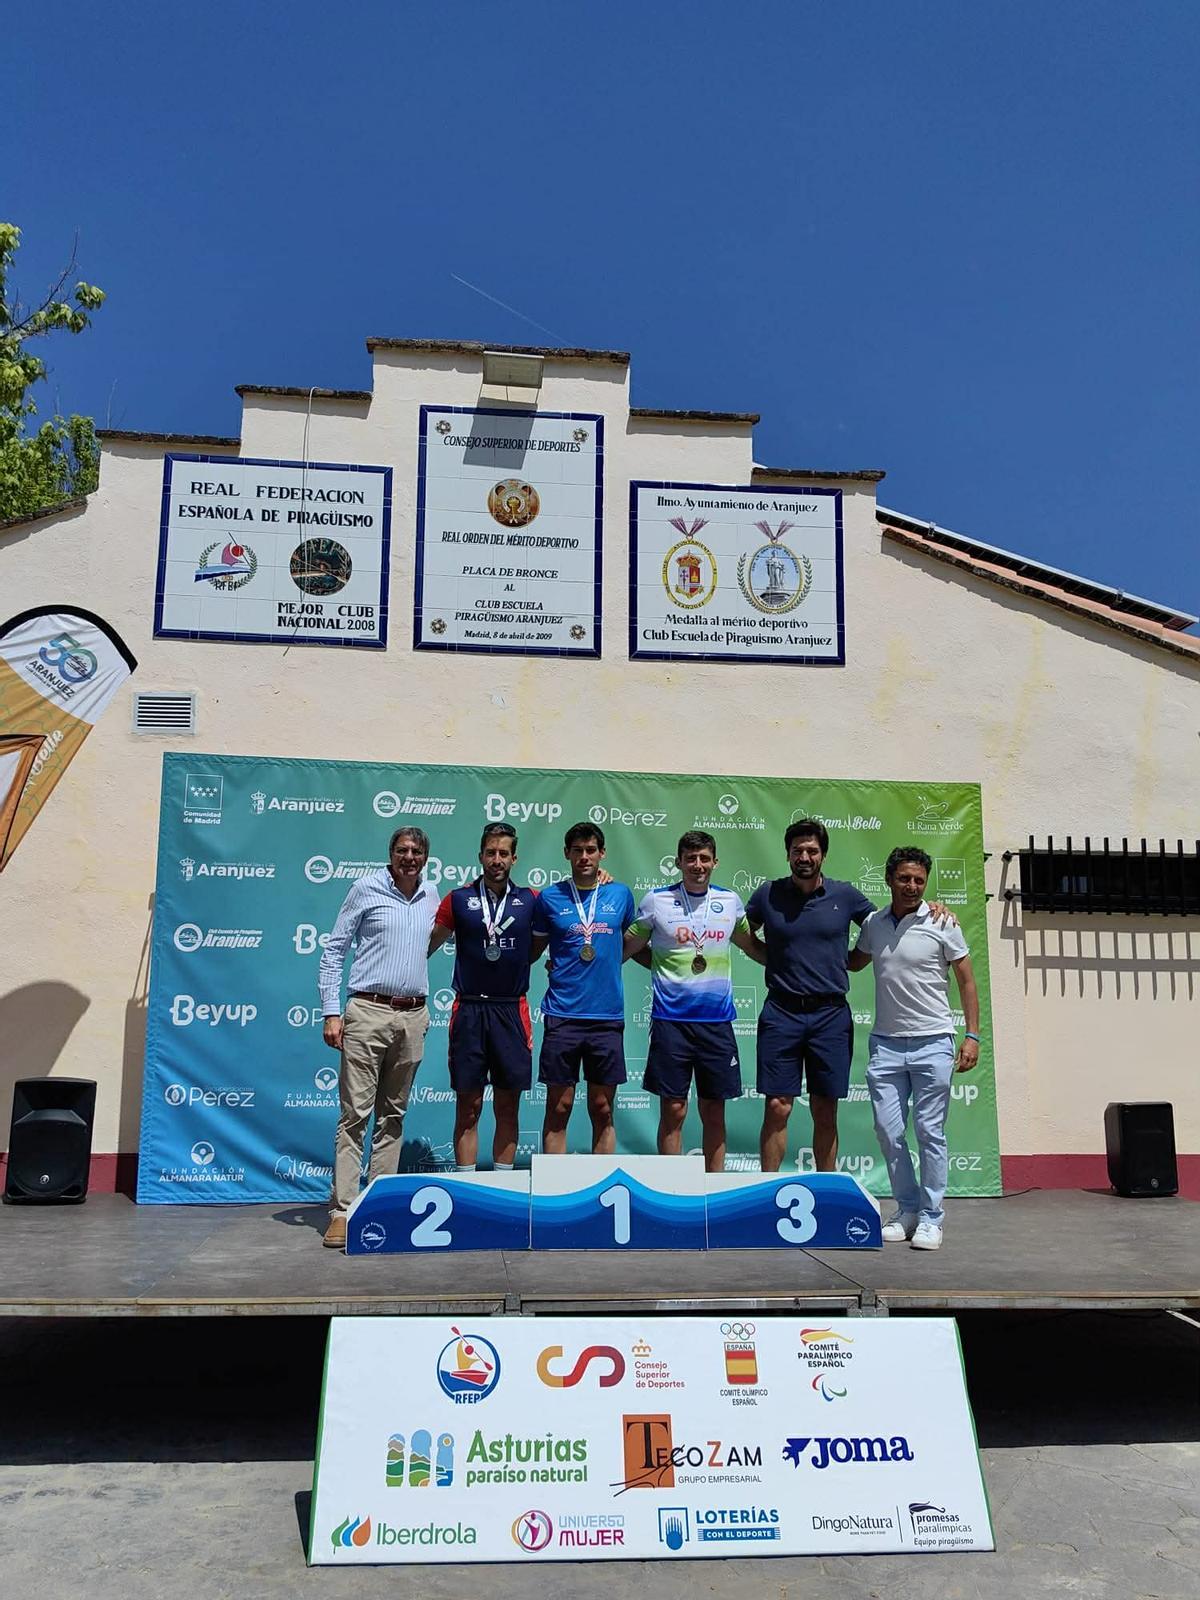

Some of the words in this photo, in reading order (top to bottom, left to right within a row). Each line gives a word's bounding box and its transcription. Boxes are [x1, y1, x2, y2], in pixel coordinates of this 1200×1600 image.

[443, 435, 481, 449] CONSEJO
[482, 438, 524, 450] SUPERIOR
[525, 439, 537, 450] DE
[537, 440, 581, 453] DEPORTES
[191, 481, 240, 497] REAL
[256, 485, 364, 504] FEDERACION
[657, 495, 682, 507] Ilmo.
[684, 496, 754, 511] Ayuntamiento
[756, 500, 769, 511] de
[770, 500, 818, 514] Aranjuez
[178, 504, 254, 522] ESPAÑOLA
[261, 508, 280, 522] DE
[287, 509, 373, 528] PIRAGÜISMO
[442, 531, 461, 544] REAL
[462, 532, 490, 545] ORDEN
[490, 534, 506, 545] DEL
[506, 533, 536, 547] MÉRITO
[536, 536, 579, 549] DEPORTIVO
[462, 566, 496, 577] PLACA
[499, 567, 514, 577] DE
[515, 568, 558, 579] BRONCE
[503, 583, 516, 592] AL
[277, 602, 324, 616] MEJOR
[338, 605, 374, 618] CLUB
[474, 599, 501, 609] CLUB
[501, 600, 544, 611] ESCUELA
[277, 615, 346, 630] NACIONAL
[454, 611, 514, 623] PIRAGÜISMO
[515, 613, 563, 625] ARANJUEZ
[665, 613, 709, 626] Medalla
[710, 615, 720, 626] al
[722, 616, 756, 628] mérito
[758, 617, 808, 631] deportivo
[464, 629, 492, 640] Madrid,
[492, 630, 498, 639] 8
[499, 631, 509, 640] de
[509, 631, 525, 641] abril
[525, 632, 535, 641] de
[535, 632, 553, 642] 2009
[643, 630, 670, 641] Club
[671, 630, 709, 642] Escuela
[710, 631, 724, 642] de
[785, 634, 832, 648] Aranjuez
[28, 660, 76, 698] ARANJUEZ
[268, 797, 345, 815] Aranjuez
[400, 801, 456, 816] Aranjuez
[484, 793, 562, 823] Beyup
[184, 810, 222, 819] Comunidad
[194, 817, 221, 825] Madrid
[695, 815, 765, 823] FUNDACIÓN
[693, 821, 738, 830] ALMANARA
[738, 822, 765, 831] NATUR
[852, 815, 882, 830] Belle
[907, 821, 915, 830] El
[917, 821, 937, 831] Rana
[938, 821, 964, 831] Verde
[197, 864, 275, 880] Aranjuez
[861, 883, 881, 892] Rana
[202, 933, 262, 949] Aranjuez
[169, 995, 257, 1027] Beyup
[420, 1087, 453, 1103] Team
[525, 1090, 535, 1100] El
[284, 1099, 336, 1107] ALMANARA
[300, 1161, 334, 1178] Team
[795, 1148, 874, 1177] Byup
[949, 1156, 982, 1171] rez
[161, 1166, 245, 1175] FUNDACIÓN
[159, 1174, 213, 1183] ALMANARA
[213, 1174, 244, 1182] NATUR
[410, 1186, 453, 1247] 2
[599, 1185, 630, 1245] 1
[775, 1183, 817, 1244] 3
[726, 1343, 752, 1351] ESPAÑA
[808, 1342, 840, 1352] COMITÉ
[797, 1350, 853, 1361] PARALÍMPICO
[634, 1360, 668, 1371] Consejo
[807, 1358, 845, 1368] ESPAÑOL
[634, 1369, 671, 1382] Superior
[635, 1380, 646, 1389] de
[648, 1379, 685, 1391] Deportes
[454, 1393, 480, 1405] RFEP
[720, 1388, 741, 1397] COMITÉ
[742, 1388, 769, 1398] OLÍMPICO
[732, 1397, 758, 1407] ESPAÑOL
[466, 1429, 588, 1463] Asturias
[466, 1464, 527, 1488] paraíso
[530, 1465, 588, 1483] natural
[678, 1475, 707, 1485] GRUPO
[707, 1475, 762, 1485] EMPRESARIAL
[559, 1515, 625, 1528] UNIVERSO
[696, 1506, 779, 1524] LOTERÍAS
[916, 1513, 960, 1525] promesas
[812, 1513, 893, 1532] DingoNatura
[917, 1522, 973, 1536] paralímpicas
[376, 1522, 476, 1545] Iberdrola
[559, 1529, 625, 1546] MUJER
[706, 1531, 722, 1539] CON
[725, 1530, 734, 1538] EL
[736, 1529, 772, 1538] DEPORTE
[914, 1536, 936, 1547] Equipo
[937, 1536, 974, 1547] piragüismo
